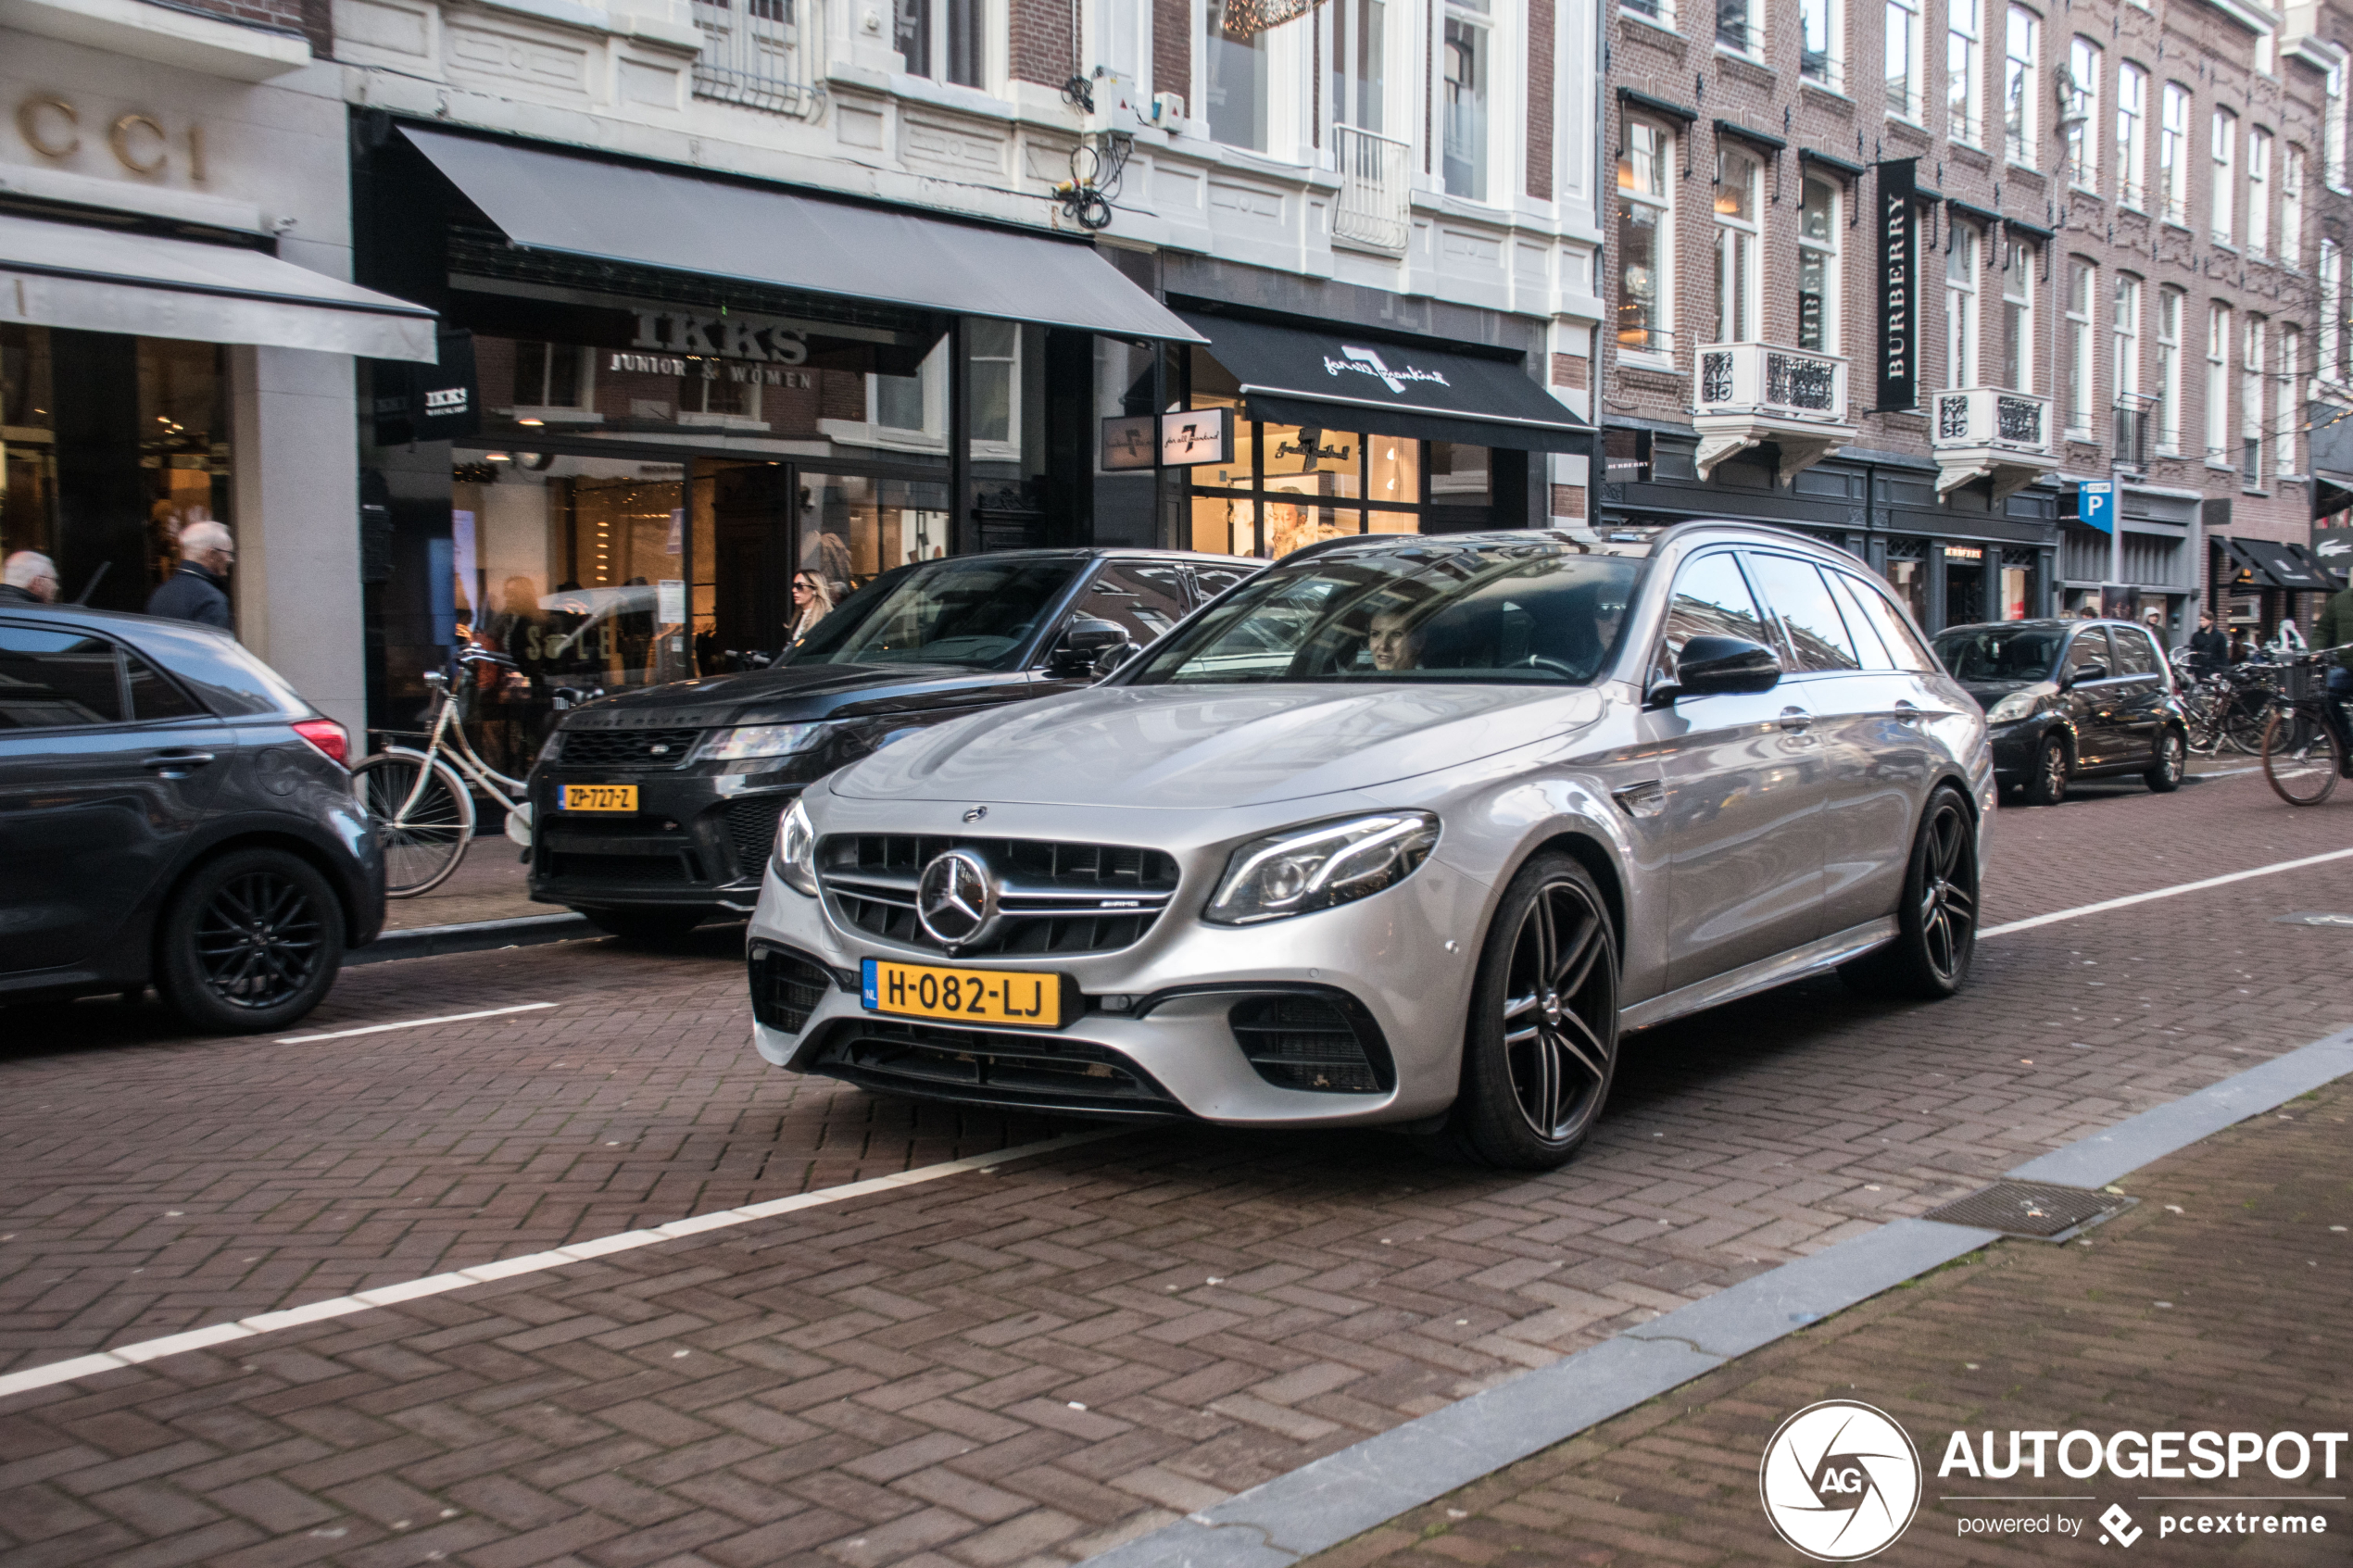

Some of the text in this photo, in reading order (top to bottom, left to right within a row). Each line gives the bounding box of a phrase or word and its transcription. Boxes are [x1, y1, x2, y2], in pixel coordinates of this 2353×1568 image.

[1888, 193, 1905, 380] BURBERRY
[631, 307, 808, 366] IKKS
[610, 353, 687, 377] JUNIOR
[730, 364, 812, 389] WOMEN
[2088, 495, 2103, 516] P
[571, 788, 630, 808] ZP-727-Z
[865, 988, 877, 1001] NL
[887, 970, 1042, 1017] H-082-LJ
